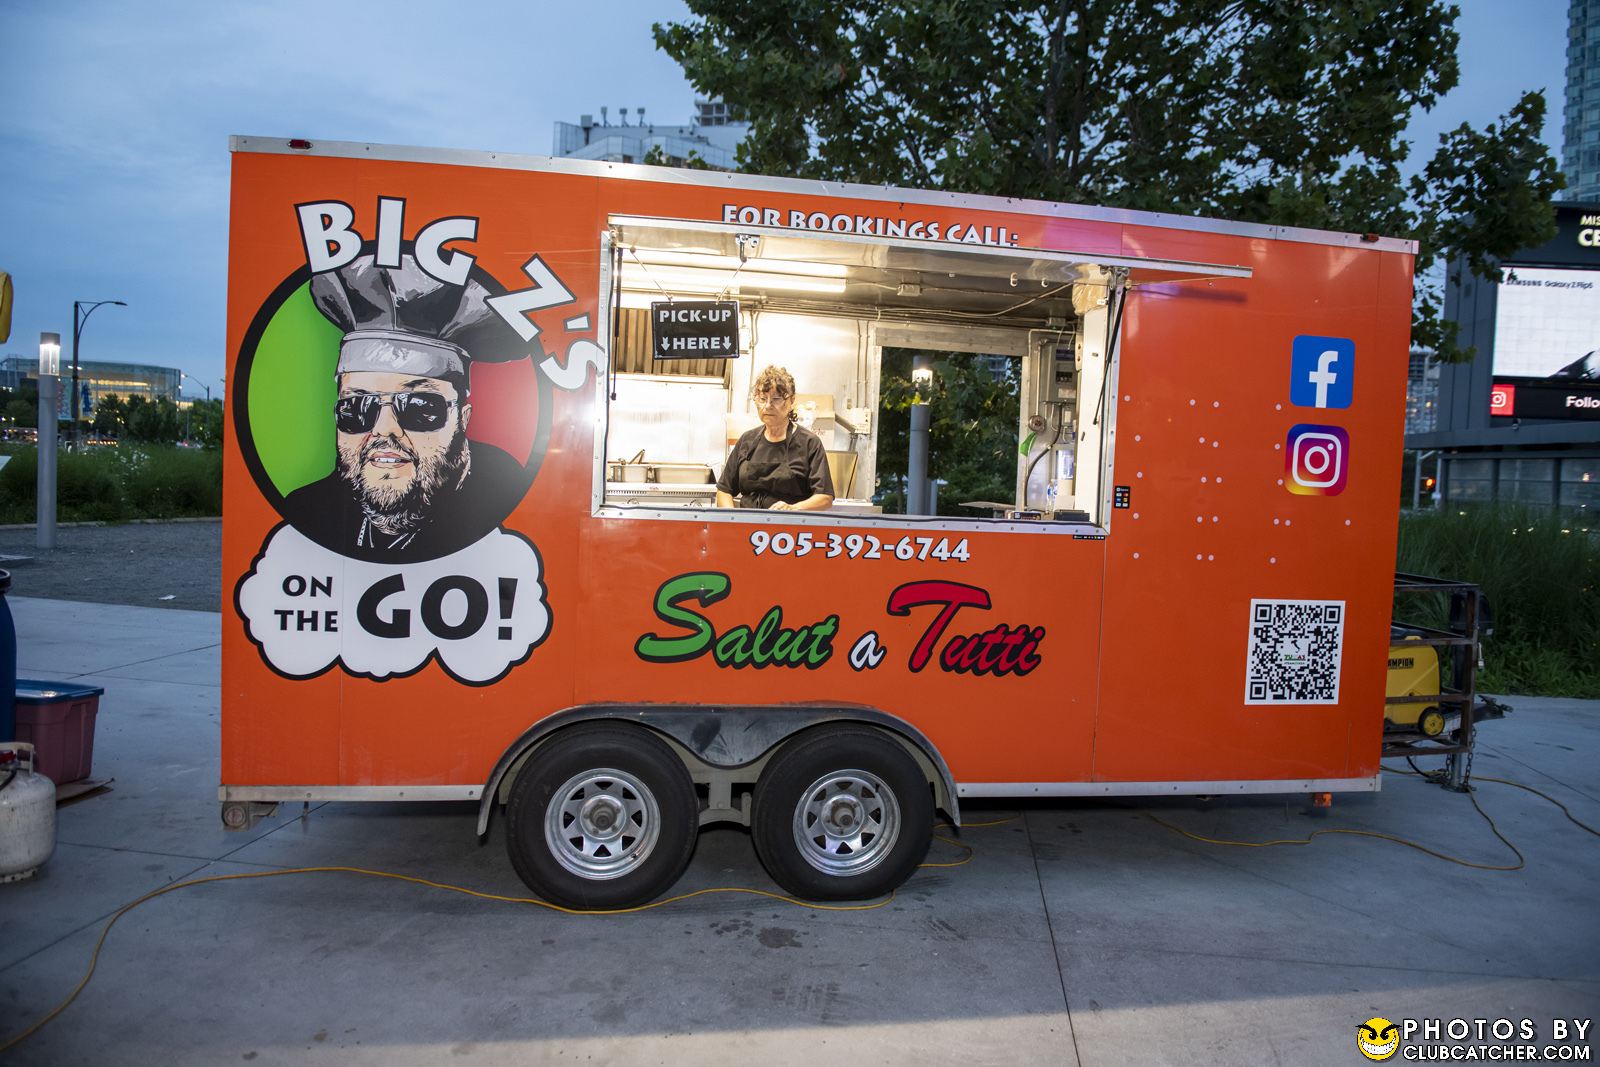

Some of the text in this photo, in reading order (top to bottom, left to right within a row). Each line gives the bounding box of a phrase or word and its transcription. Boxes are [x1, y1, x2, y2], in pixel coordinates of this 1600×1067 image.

[722, 204, 781, 226] FOR
[789, 210, 938, 241] BOOKINGS
[294, 195, 480, 287] BIG
[659, 309, 732, 323] PICK-UP
[673, 336, 721, 350] HERE
[749, 530, 971, 563] 905-392-6744
[281, 574, 333, 597] ON
[274, 609, 339, 632] THE
[356, 573, 519, 641] GO!
[634, 571, 1046, 676] Salut a Tutti
